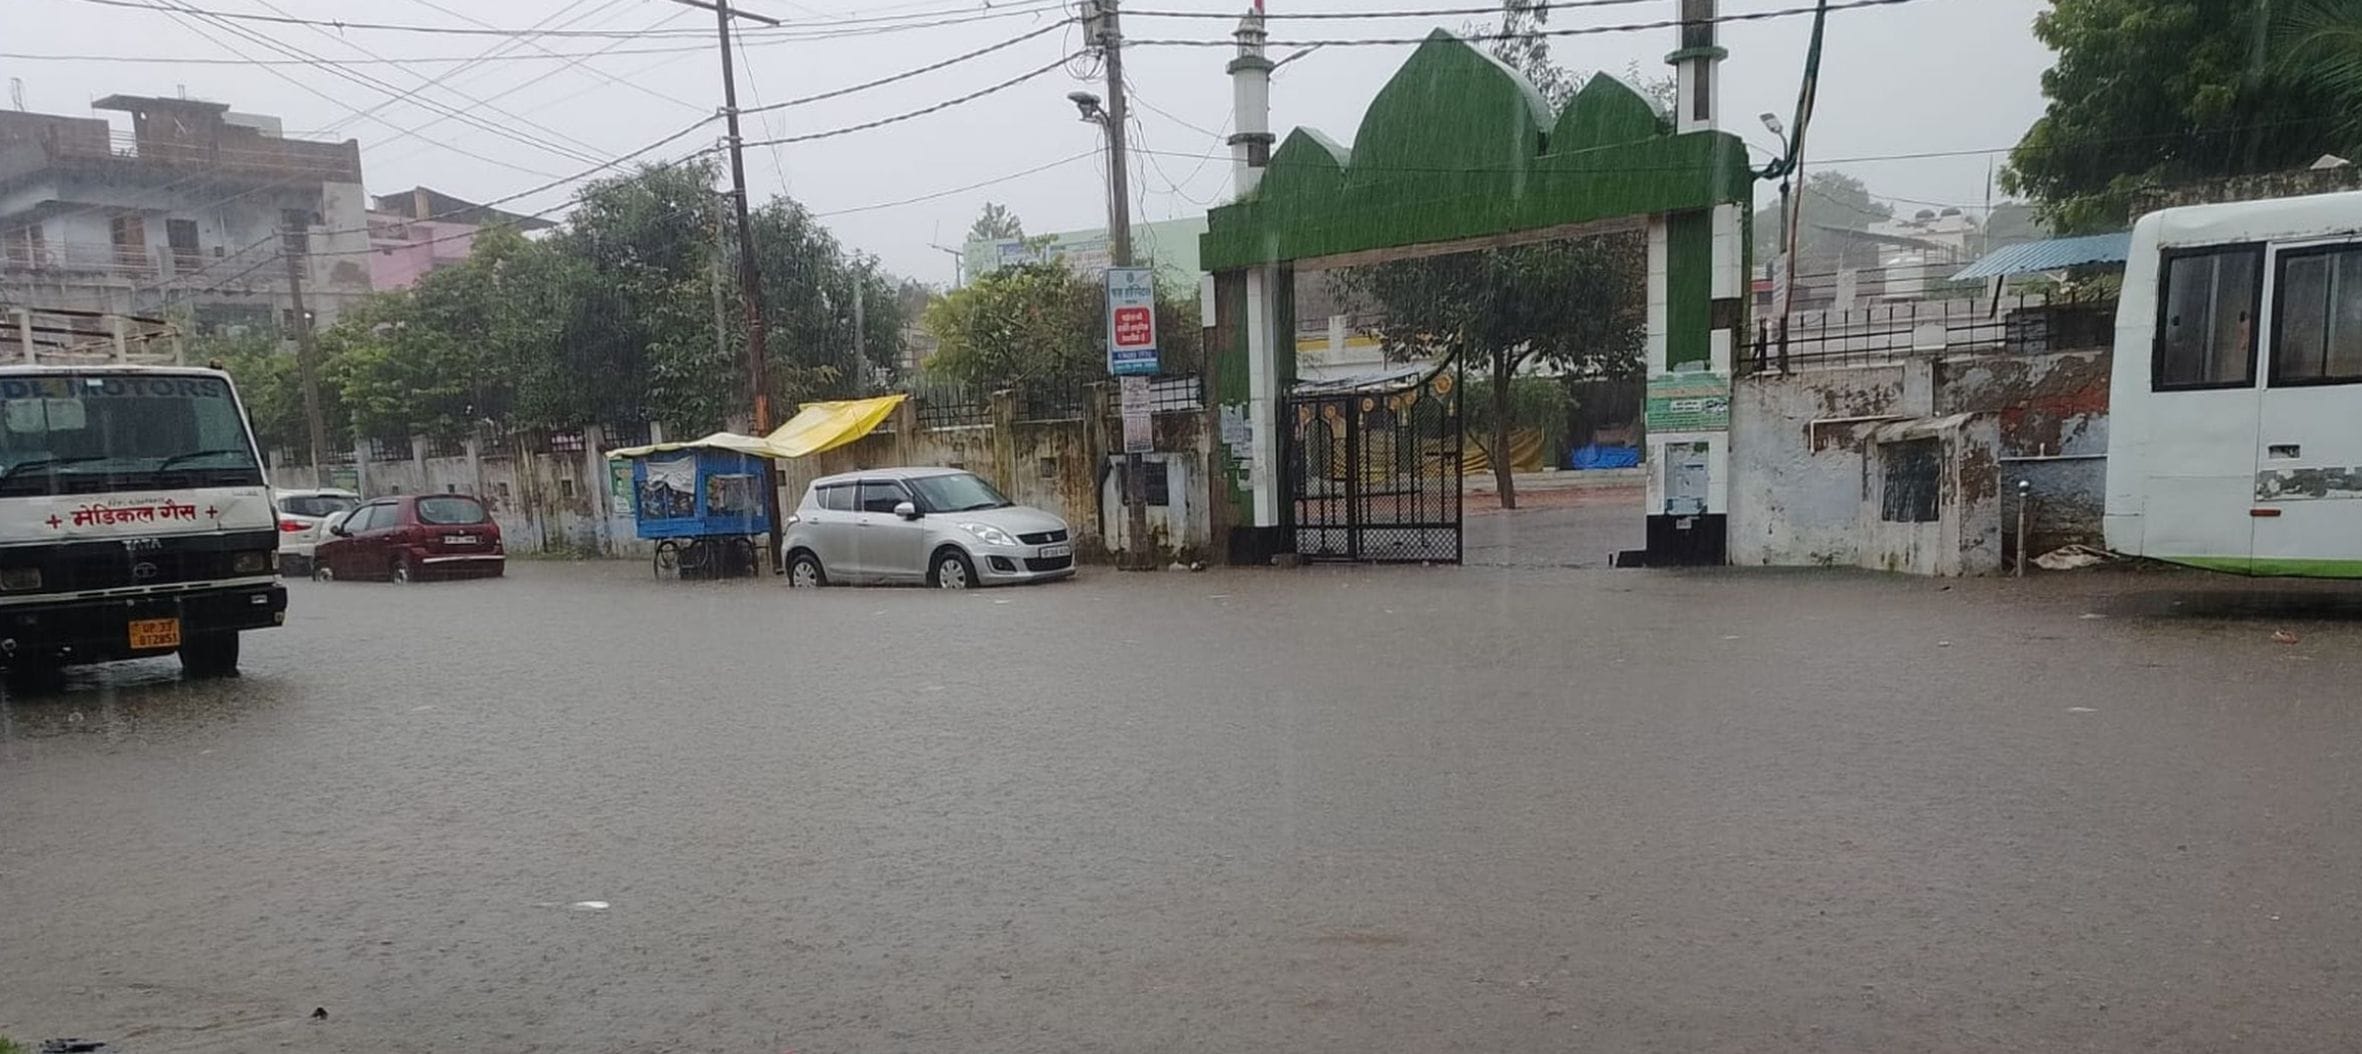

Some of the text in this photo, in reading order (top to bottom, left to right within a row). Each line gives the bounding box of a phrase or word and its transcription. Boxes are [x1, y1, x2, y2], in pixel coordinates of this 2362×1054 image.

[67, 379, 219, 398] MOTORS
[71, 499, 196, 526] मेडिकल गैस
[122, 538, 162, 551] TATA
